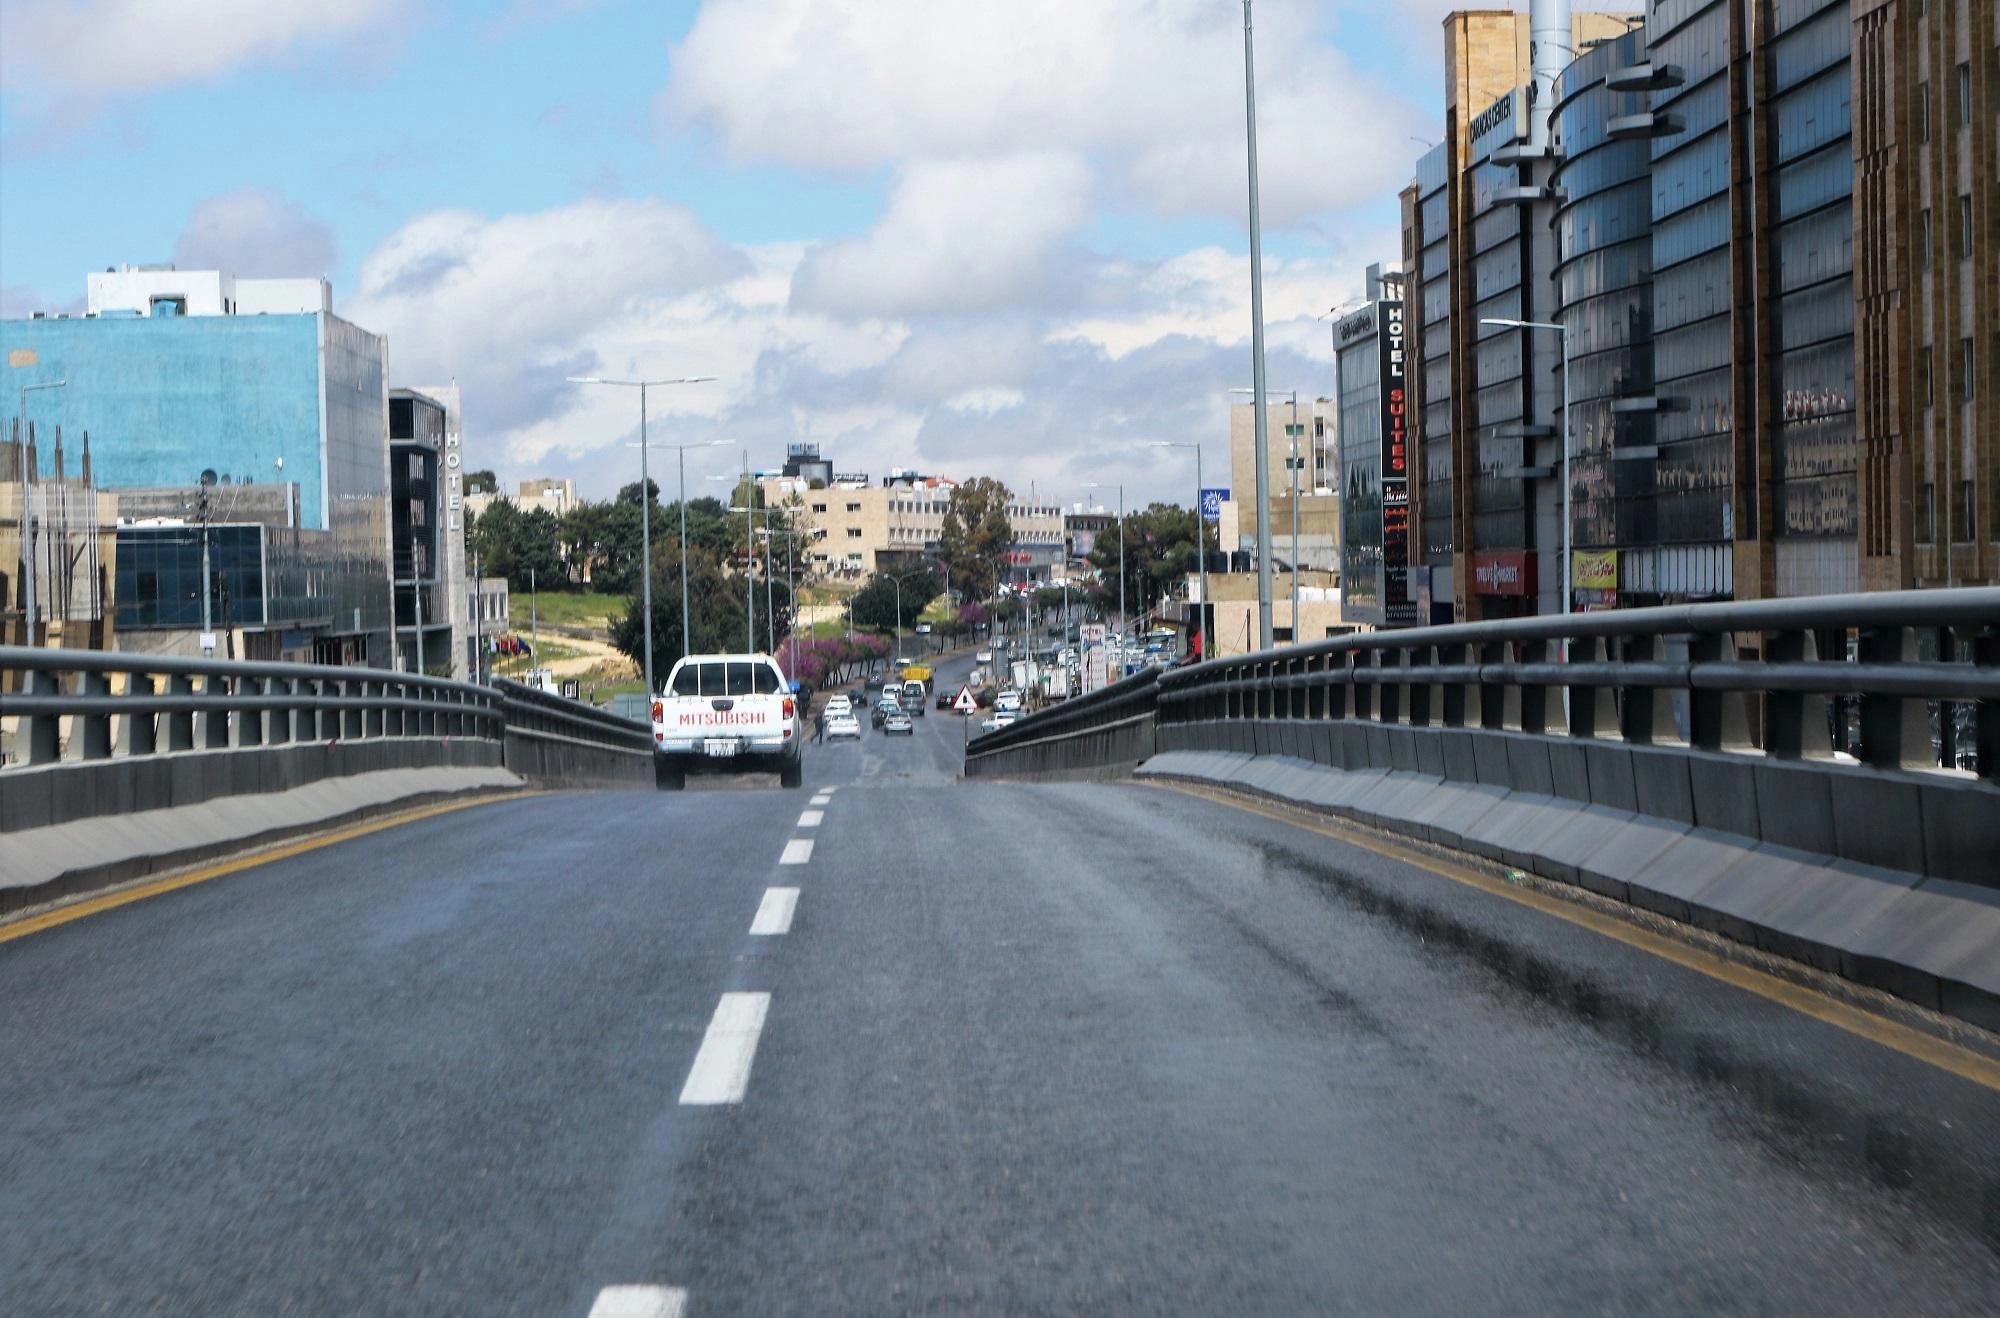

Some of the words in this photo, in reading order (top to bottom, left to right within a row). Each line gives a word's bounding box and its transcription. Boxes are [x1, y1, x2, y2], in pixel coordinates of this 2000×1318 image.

[1492, 95, 1511, 128] CENTER
[1389, 308, 1403, 377] HOTEL
[1391, 389, 1405, 470] SUITES
[447, 431, 460, 531] HOTEL
[679, 711, 766, 726] MITSUBISHI
